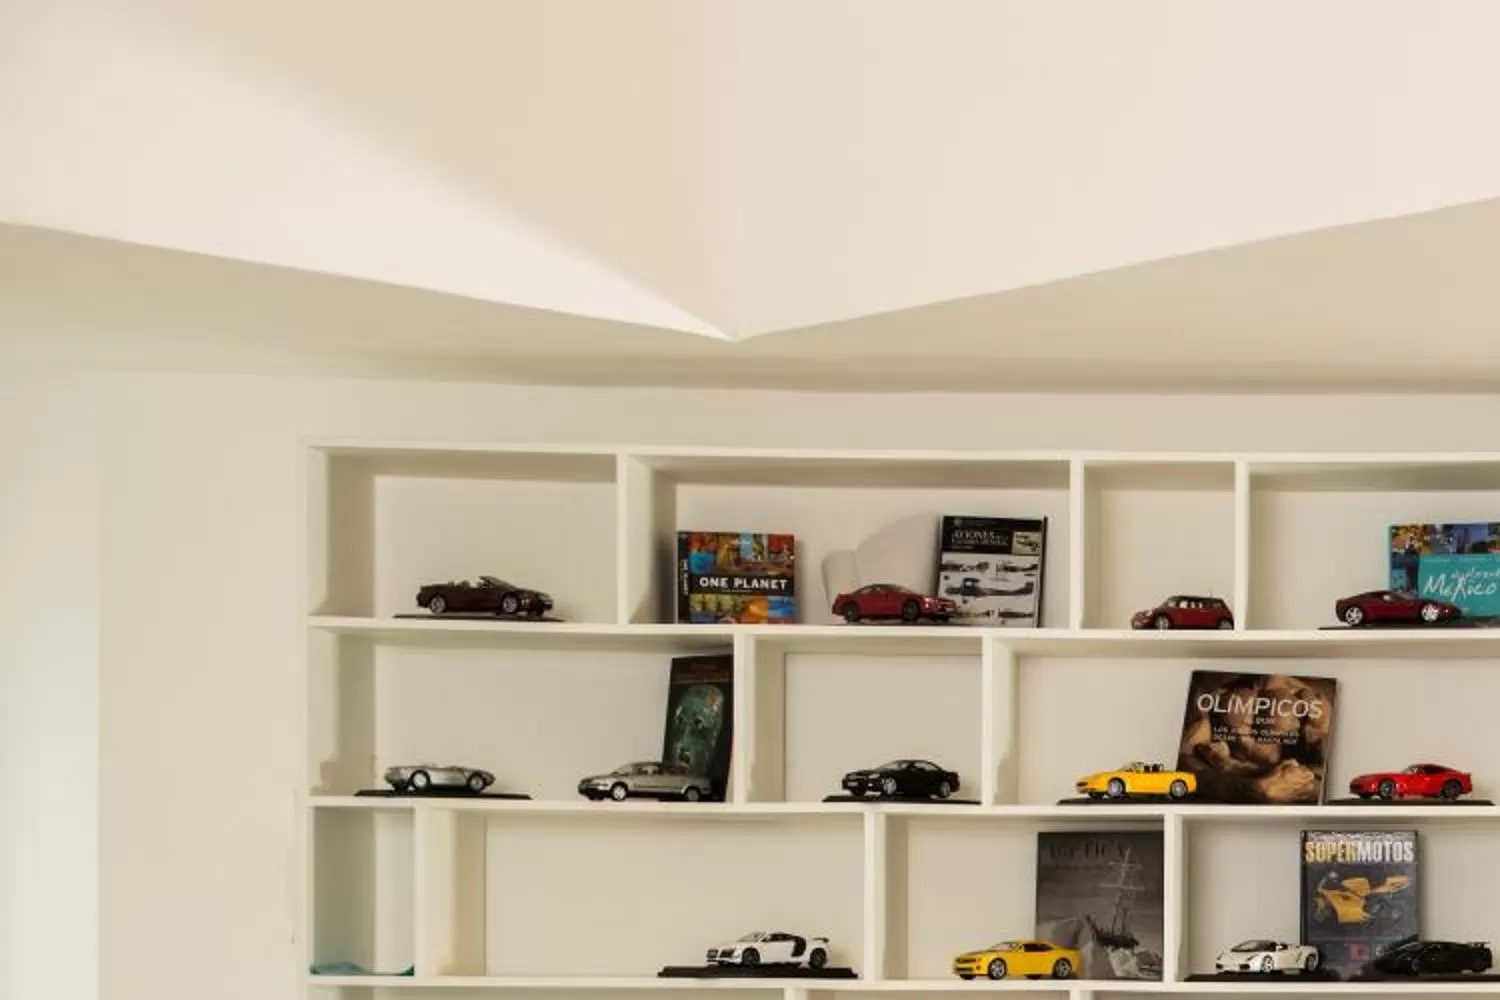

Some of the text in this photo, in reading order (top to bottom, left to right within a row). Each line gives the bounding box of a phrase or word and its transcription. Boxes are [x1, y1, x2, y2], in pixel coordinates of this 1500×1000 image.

[700, 577, 788, 590] ONE PLANET
[1305, 840, 1414, 863] SUPERMOTOS
